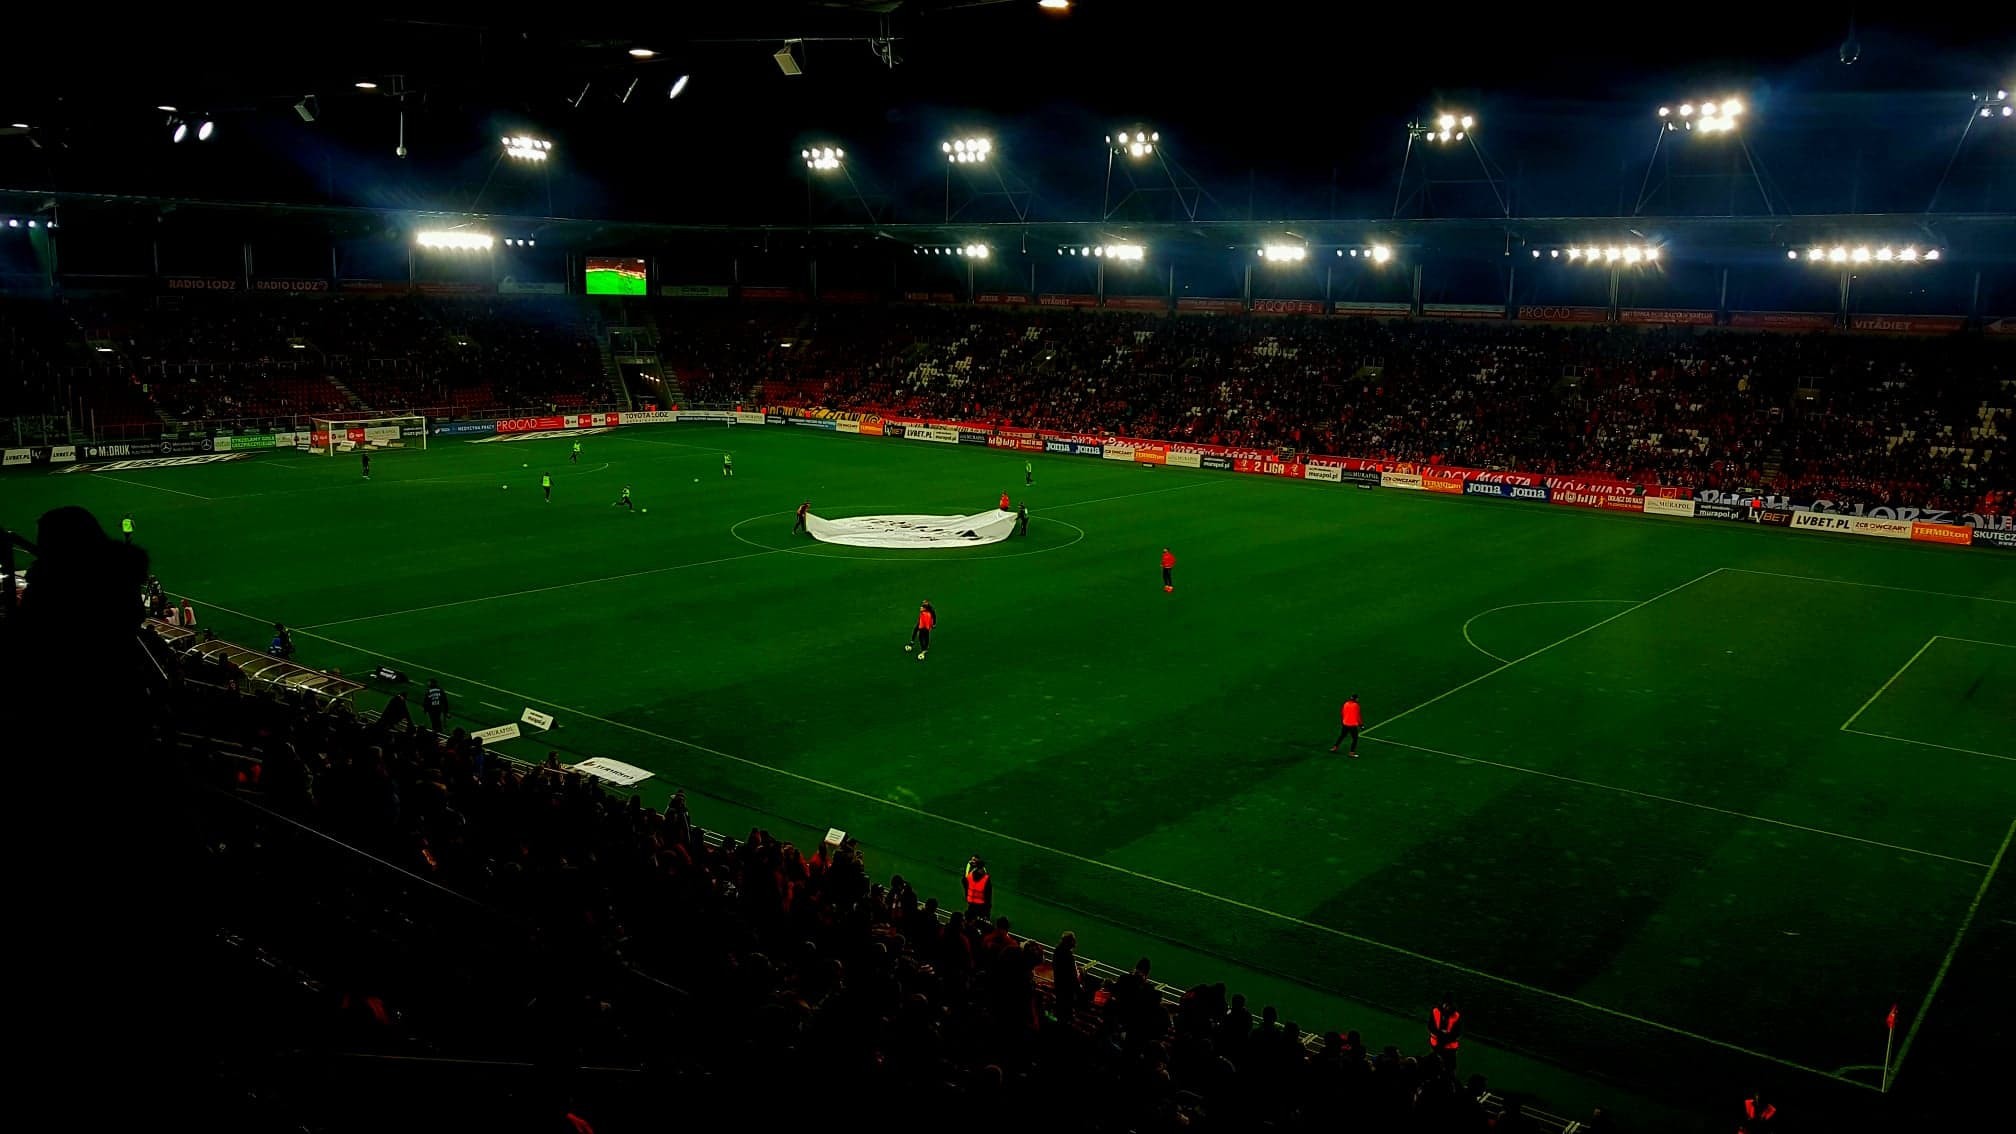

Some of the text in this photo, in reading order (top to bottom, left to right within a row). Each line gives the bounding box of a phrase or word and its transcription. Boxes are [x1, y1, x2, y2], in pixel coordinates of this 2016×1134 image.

[496, 418, 537, 432] PROCAD
[1254, 461, 1261, 472] 2
[1263, 462, 1285, 475] LIGA
[1659, 501, 1690, 509] MURAPOL
[1699, 509, 1739, 519] murapol.pl
[1796, 515, 1850, 529] LVBET.PL
[1870, 523, 1907, 531] OWCZARY
